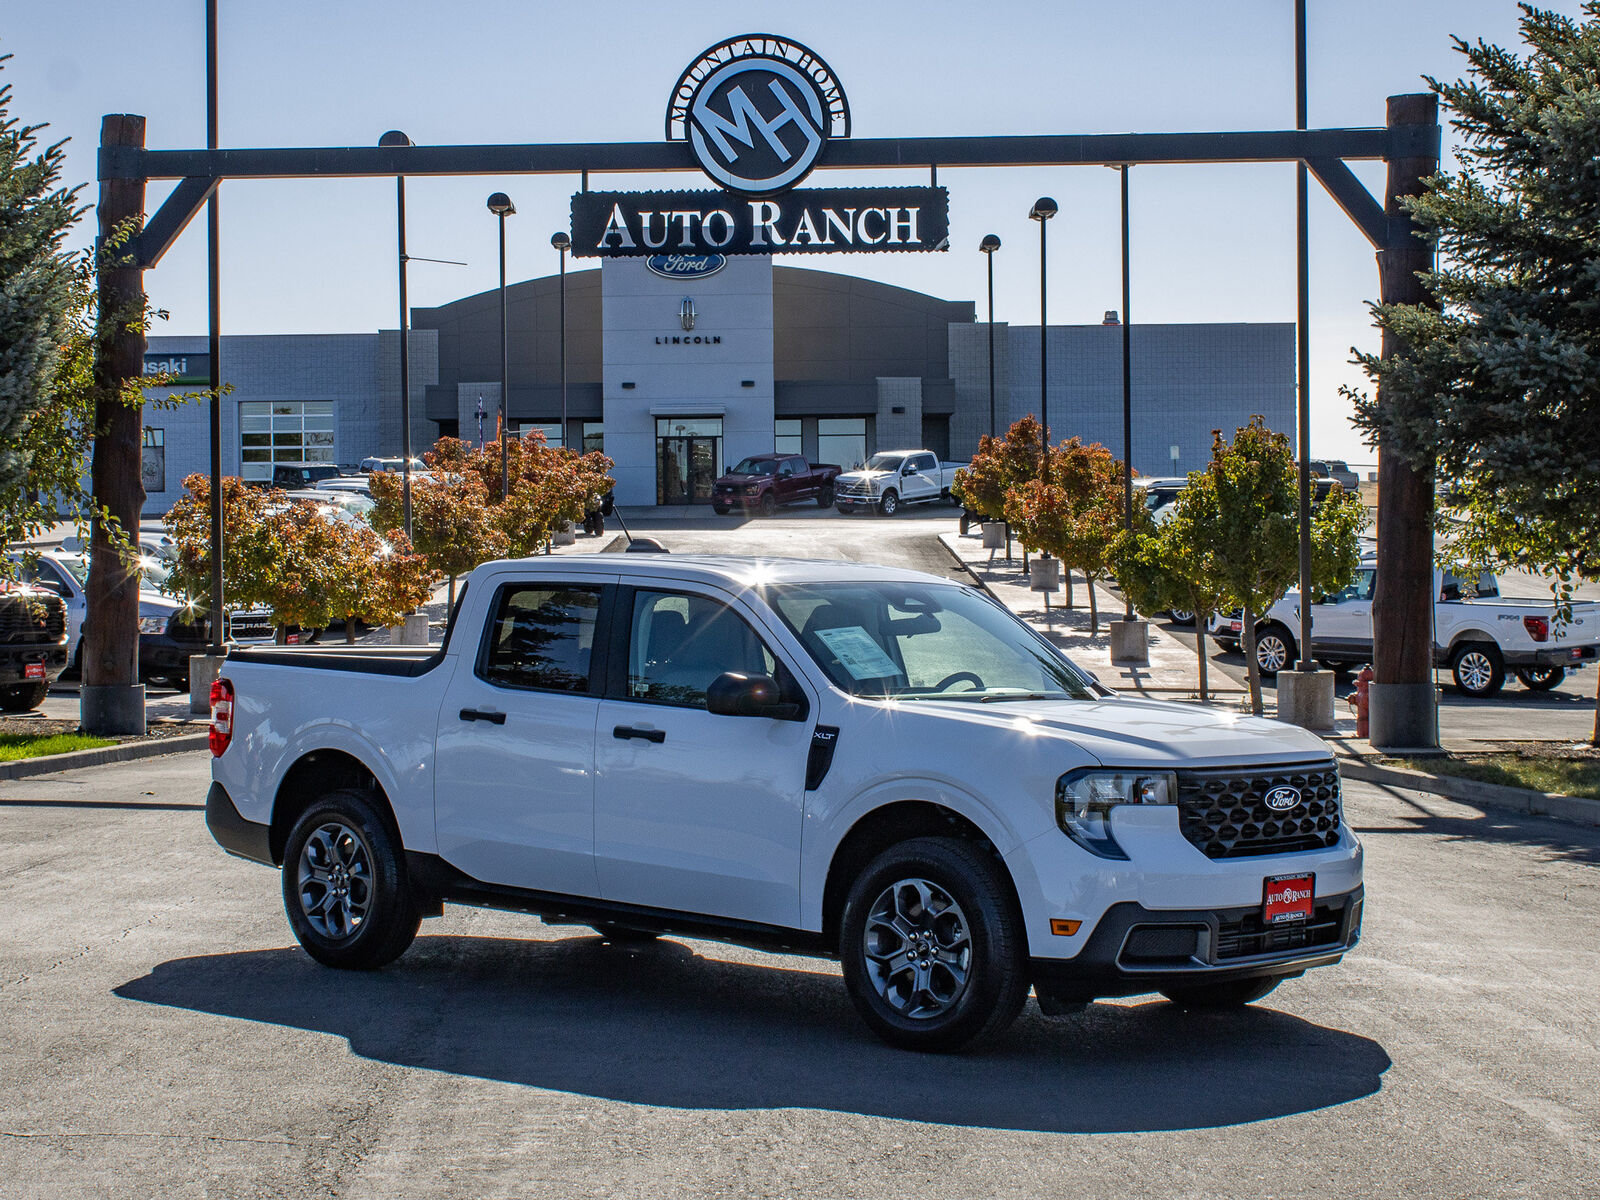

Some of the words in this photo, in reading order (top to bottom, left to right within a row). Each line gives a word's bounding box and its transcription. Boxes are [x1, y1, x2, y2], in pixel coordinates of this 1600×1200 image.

[672, 39, 789, 122] MOUNTAIN
[798, 52, 846, 122] HOME
[692, 78, 822, 164] MH
[597, 202, 735, 249] AUTO
[748, 200, 923, 247] RANCH
[664, 253, 709, 272] Ford
[655, 336, 721, 345] LINCOLN
[814, 732, 835, 740] XLT
[1272, 790, 1295, 807] Ford
[1266, 893, 1283, 905] AUTO
[1292, 889, 1311, 902] RANCH
